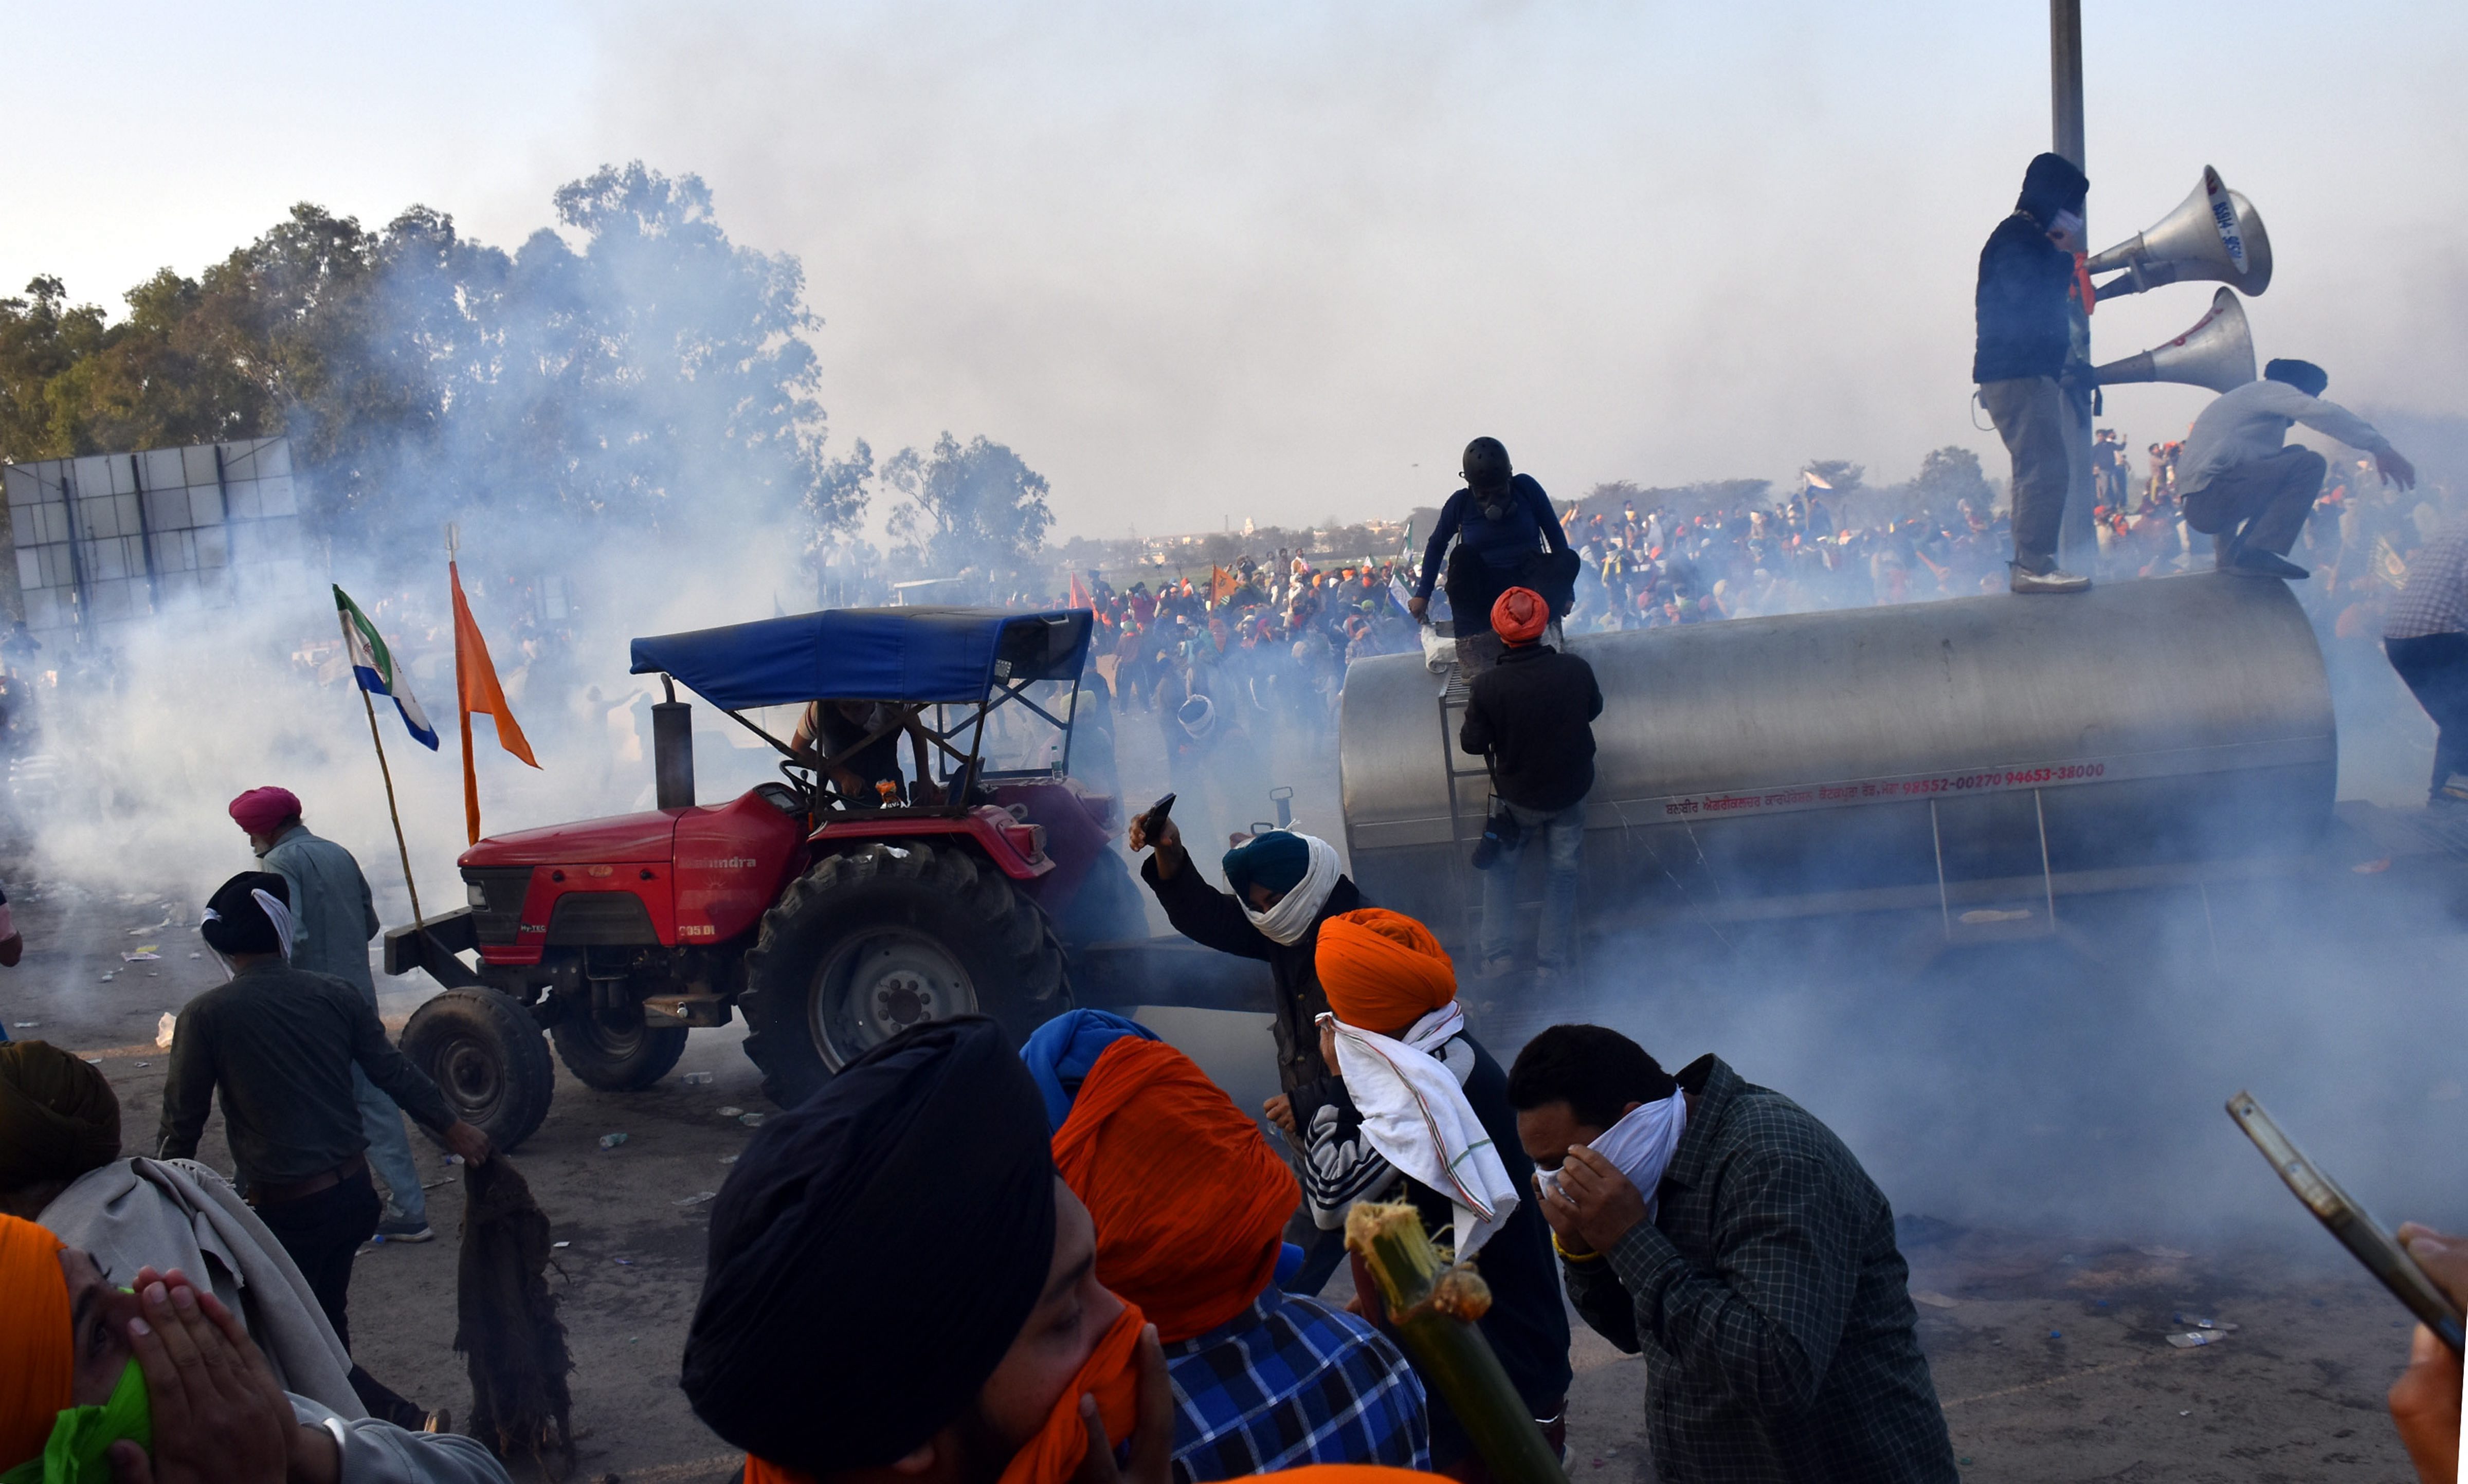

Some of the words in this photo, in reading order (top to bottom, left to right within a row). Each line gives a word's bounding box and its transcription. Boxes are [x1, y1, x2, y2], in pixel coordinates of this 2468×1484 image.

[1902, 772, 2002, 795] 98552-00270
[2005, 763, 2104, 785] 94653-38000
[703, 925, 715, 935] DI
